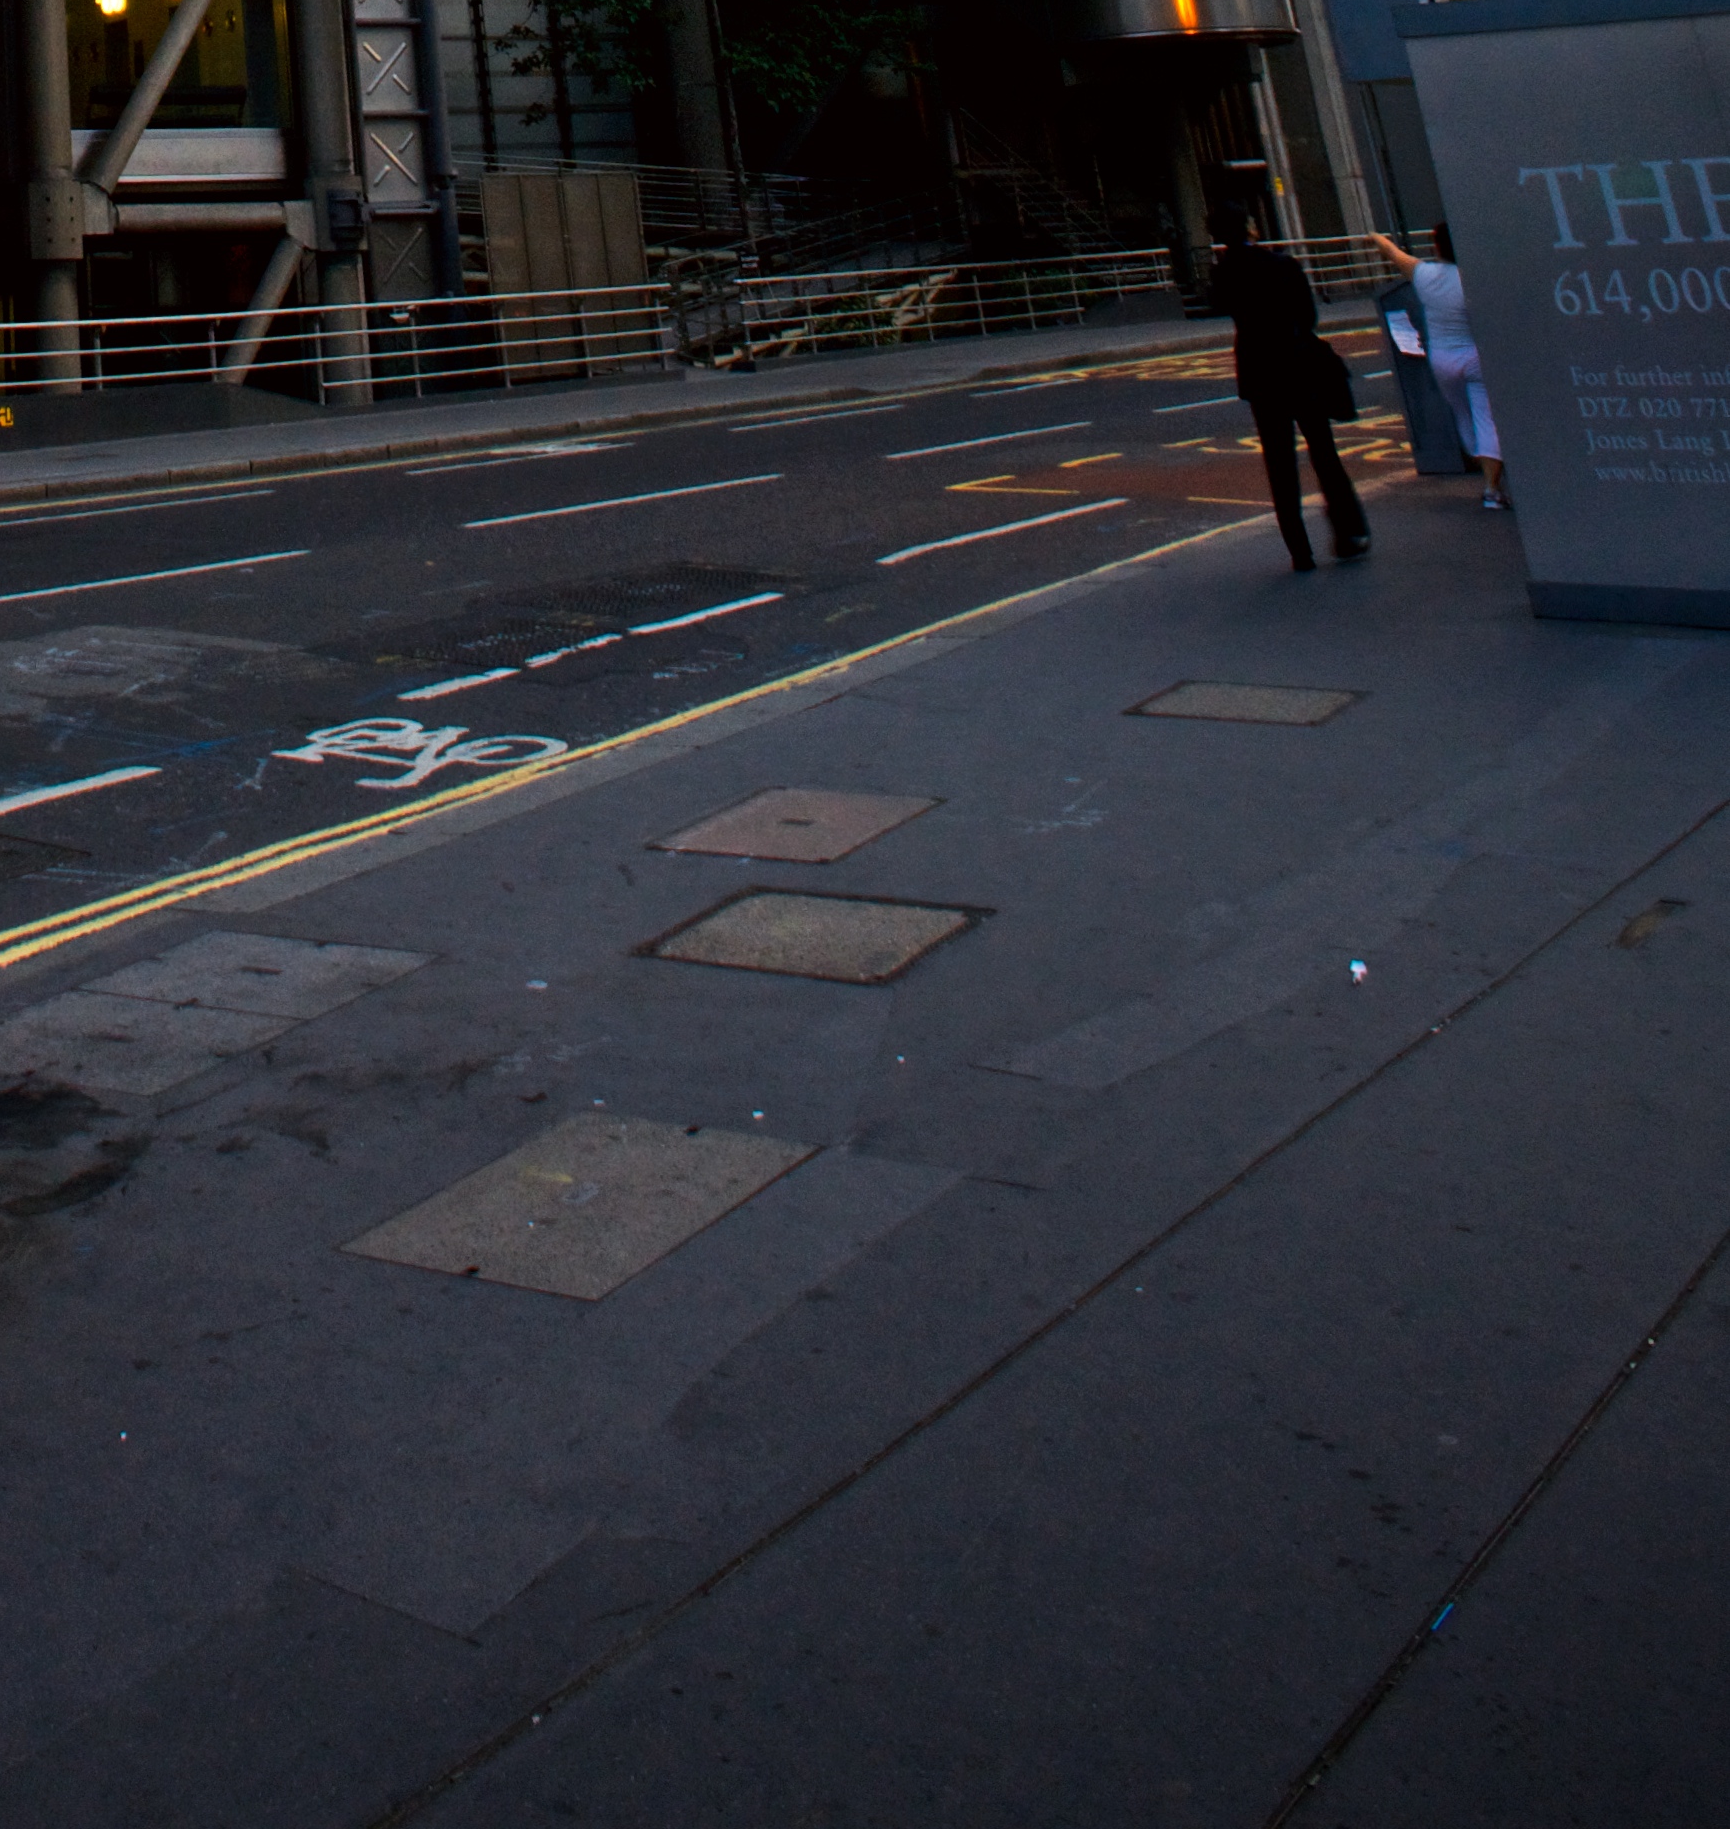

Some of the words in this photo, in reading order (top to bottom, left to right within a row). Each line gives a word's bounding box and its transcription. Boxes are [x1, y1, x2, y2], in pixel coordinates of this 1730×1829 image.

[1570, 365, 1607, 386] For
[1614, 364, 1692, 386] further
[1577, 396, 1631, 418] DTZ
[1639, 397, 1682, 418] 020
[1586, 428, 1648, 455] Jones
[1654, 428, 1714, 456] Lang
